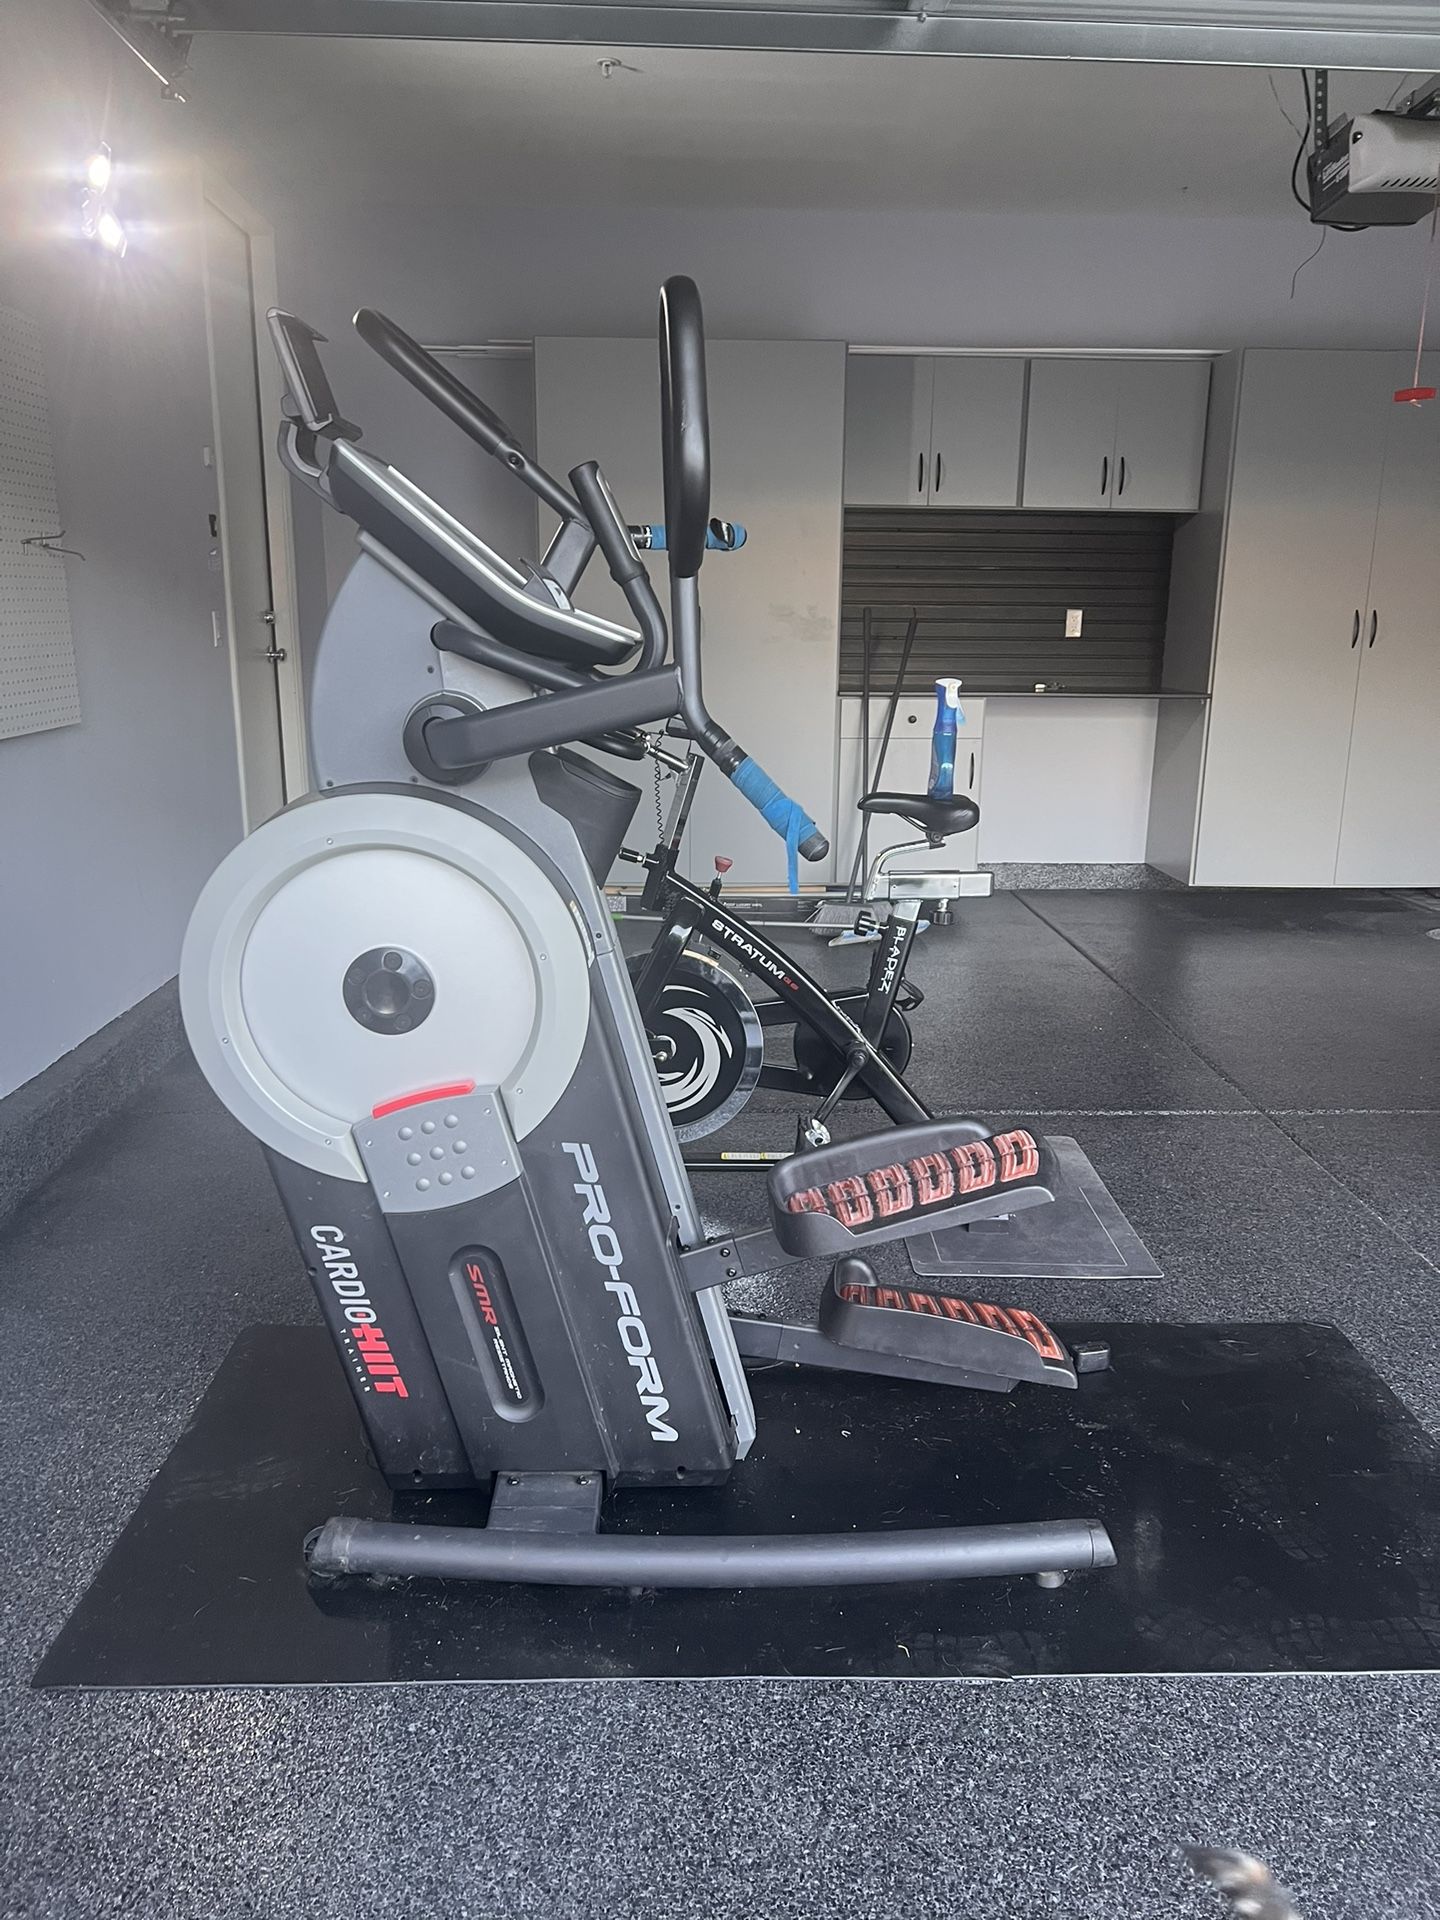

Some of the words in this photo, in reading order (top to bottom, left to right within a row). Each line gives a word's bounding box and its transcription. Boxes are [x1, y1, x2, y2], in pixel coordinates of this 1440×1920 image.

[711, 919, 785, 980] STRATUM
[878, 926, 907, 995] BLADEZ
[310, 1225, 377, 1324] CARDIO
[351, 1323, 409, 1397] HIIT
[466, 1263, 498, 1326] SMR
[561, 1142, 679, 1442] PRO-FORM
[340, 1328, 371, 1392] TRAINER
